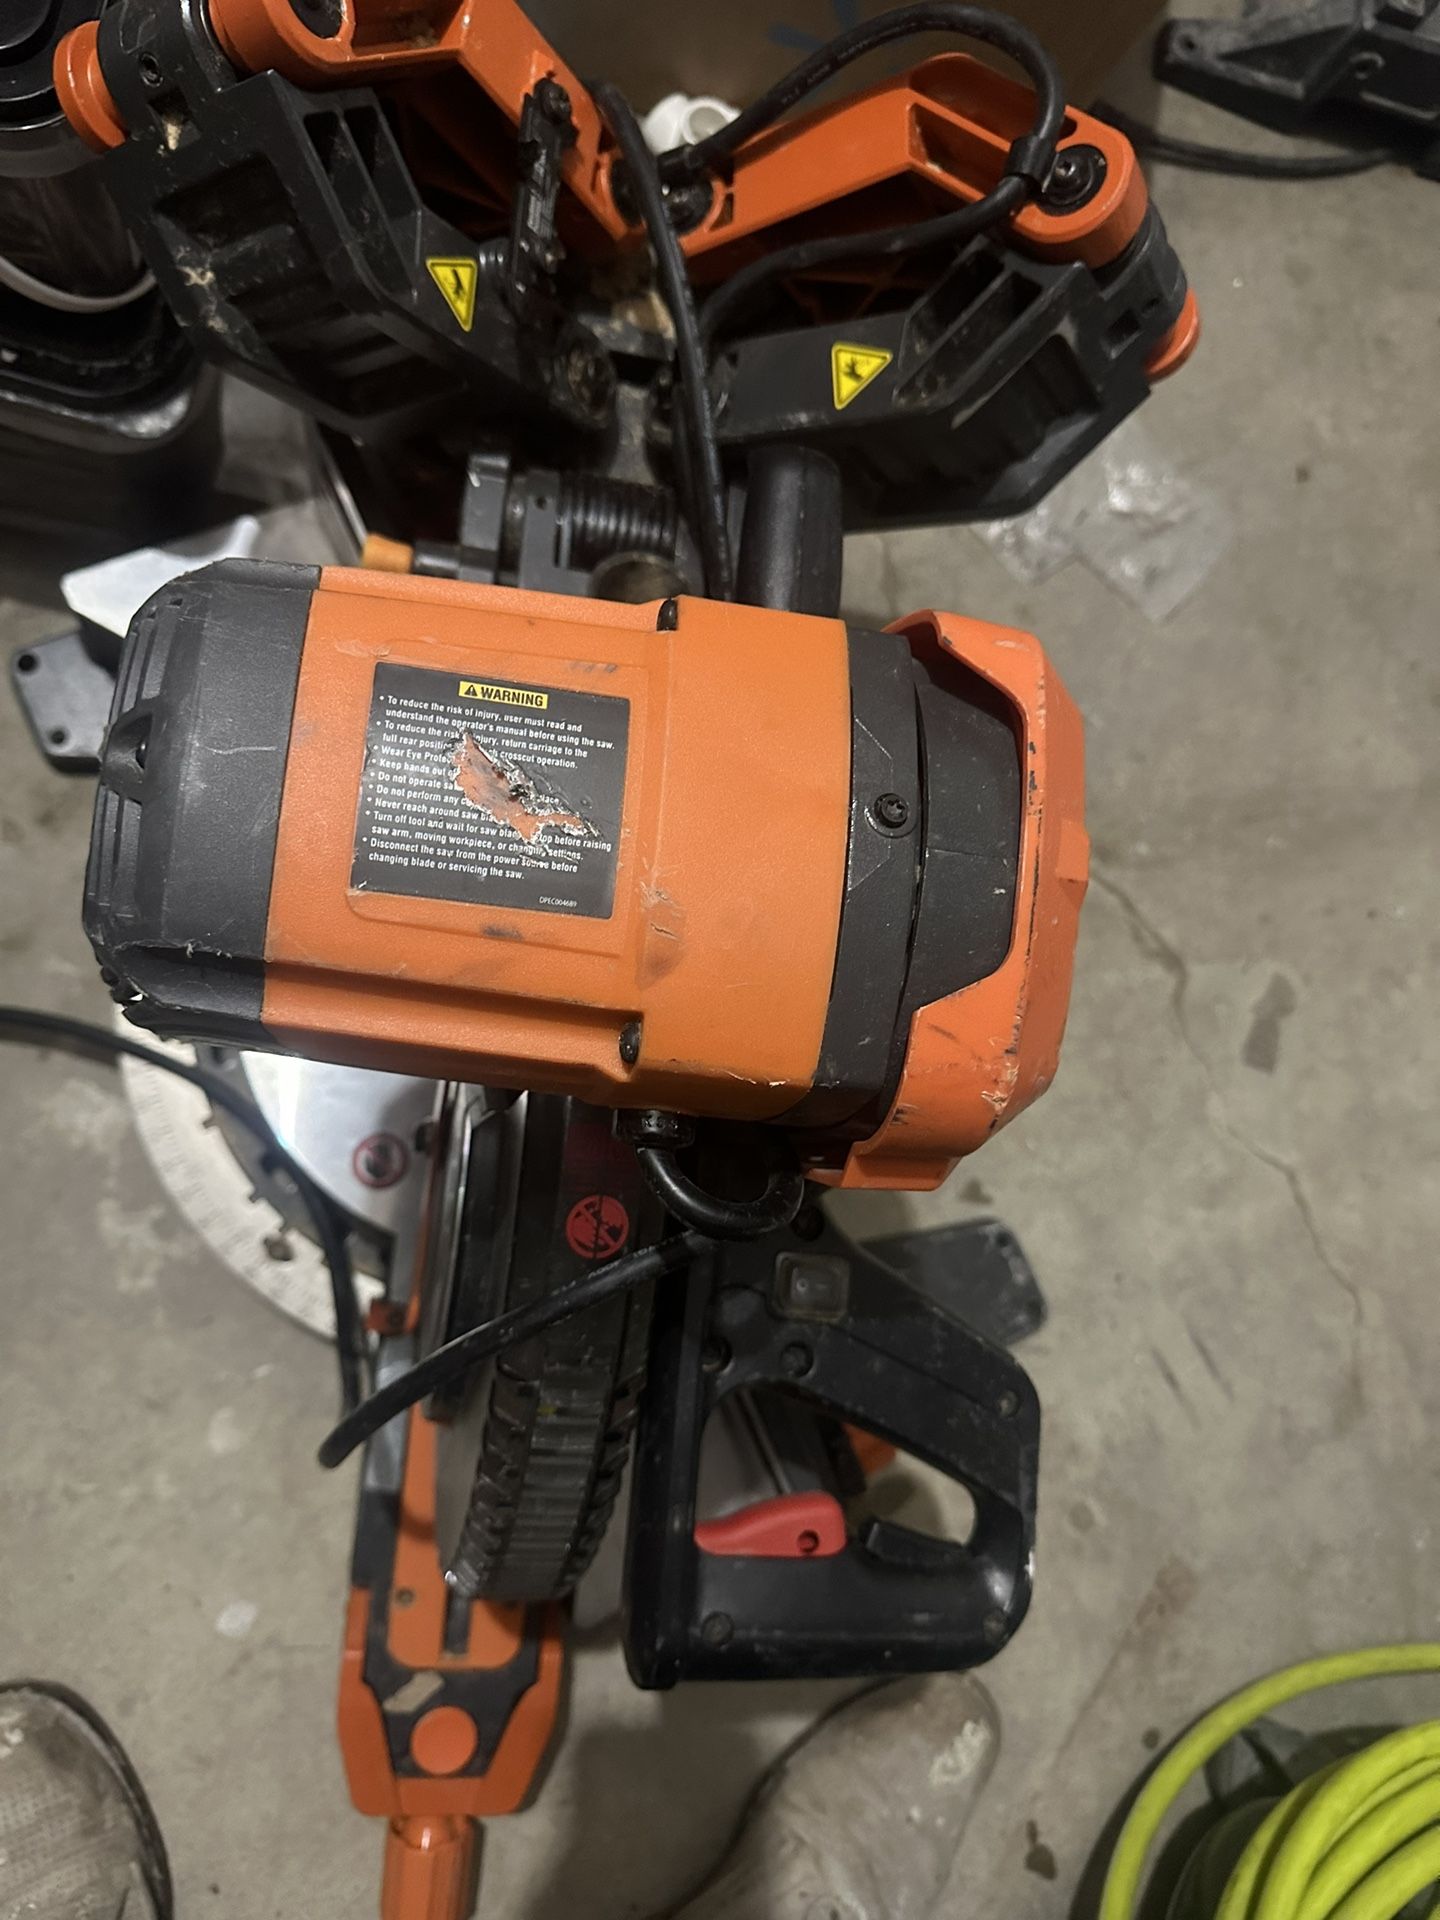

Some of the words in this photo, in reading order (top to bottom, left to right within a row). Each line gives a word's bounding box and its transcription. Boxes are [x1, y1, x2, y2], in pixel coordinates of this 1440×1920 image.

[480, 687, 544, 706] WARNING
[388, 695, 397, 704] To
[400, 698, 428, 710] reduce
[431, 702, 444, 712] the
[447, 705, 462, 715] risk
[464, 708, 473, 716] of
[504, 714, 522, 723] user
[524, 716, 544, 727] must
[546, 720, 565, 730] read
[567, 724, 582, 732] and
[384, 720, 394, 729] To
[396, 723, 426, 734] reduce
[428, 727, 442, 737] the
[444, 730, 460, 740] risk
[501, 738, 526, 748] return
[528, 741, 562, 754] carriage
[565, 746, 572, 755] to
[574, 748, 588, 758] the
[386, 708, 434, 723] understand
[436, 714, 449, 725] the
[451, 718, 494, 732] operator's
[496, 724, 527, 736] manual
[528, 729, 555, 740] before
[557, 734, 579, 746] using
[582, 737, 594, 746] the
[596, 741, 614, 750] saw.
[381, 746, 404, 756] Wear
[406, 749, 420, 759] Eye
[382, 732, 397, 742] full
[399, 736, 417, 745] rear
[500, 750, 535, 762] crosscut
[536, 756, 578, 769] operation.
[380, 758, 401, 770] Keep
[404, 762, 430, 774] hands
[432, 766, 446, 776] out
[378, 771, 390, 781] Do
[392, 774, 406, 784] not
[409, 776, 441, 789] operate
[376, 784, 388, 794] Do
[391, 787, 405, 797] not
[407, 789, 441, 802] perform
[443, 795, 459, 805] any
[375, 798, 401, 809] Never
[403, 802, 427, 813] reach
[429, 806, 459, 817] around
[461, 811, 479, 820] saw
[372, 826, 389, 835] saw
[415, 832, 446, 844] moving
[374, 811, 392, 821] Turn
[395, 814, 406, 823] off
[409, 816, 425, 826] tool
[428, 820, 443, 828] and
[446, 822, 464, 832] wait
[466, 824, 478, 832] for
[555, 836, 581, 846] before
[583, 840, 611, 852] raising
[369, 852, 409, 866] changing
[411, 857, 435, 868] blade
[449, 863, 488, 876] servicing
[490, 867, 503, 876] the
[505, 871, 524, 879] saw.
[370, 838, 418, 852] Disconnect
[421, 845, 434, 854] the
[436, 849, 453, 858] saw
[456, 849, 475, 860] from
[478, 852, 491, 862] the
[494, 855, 520, 865] power
[551, 861, 578, 872] before
